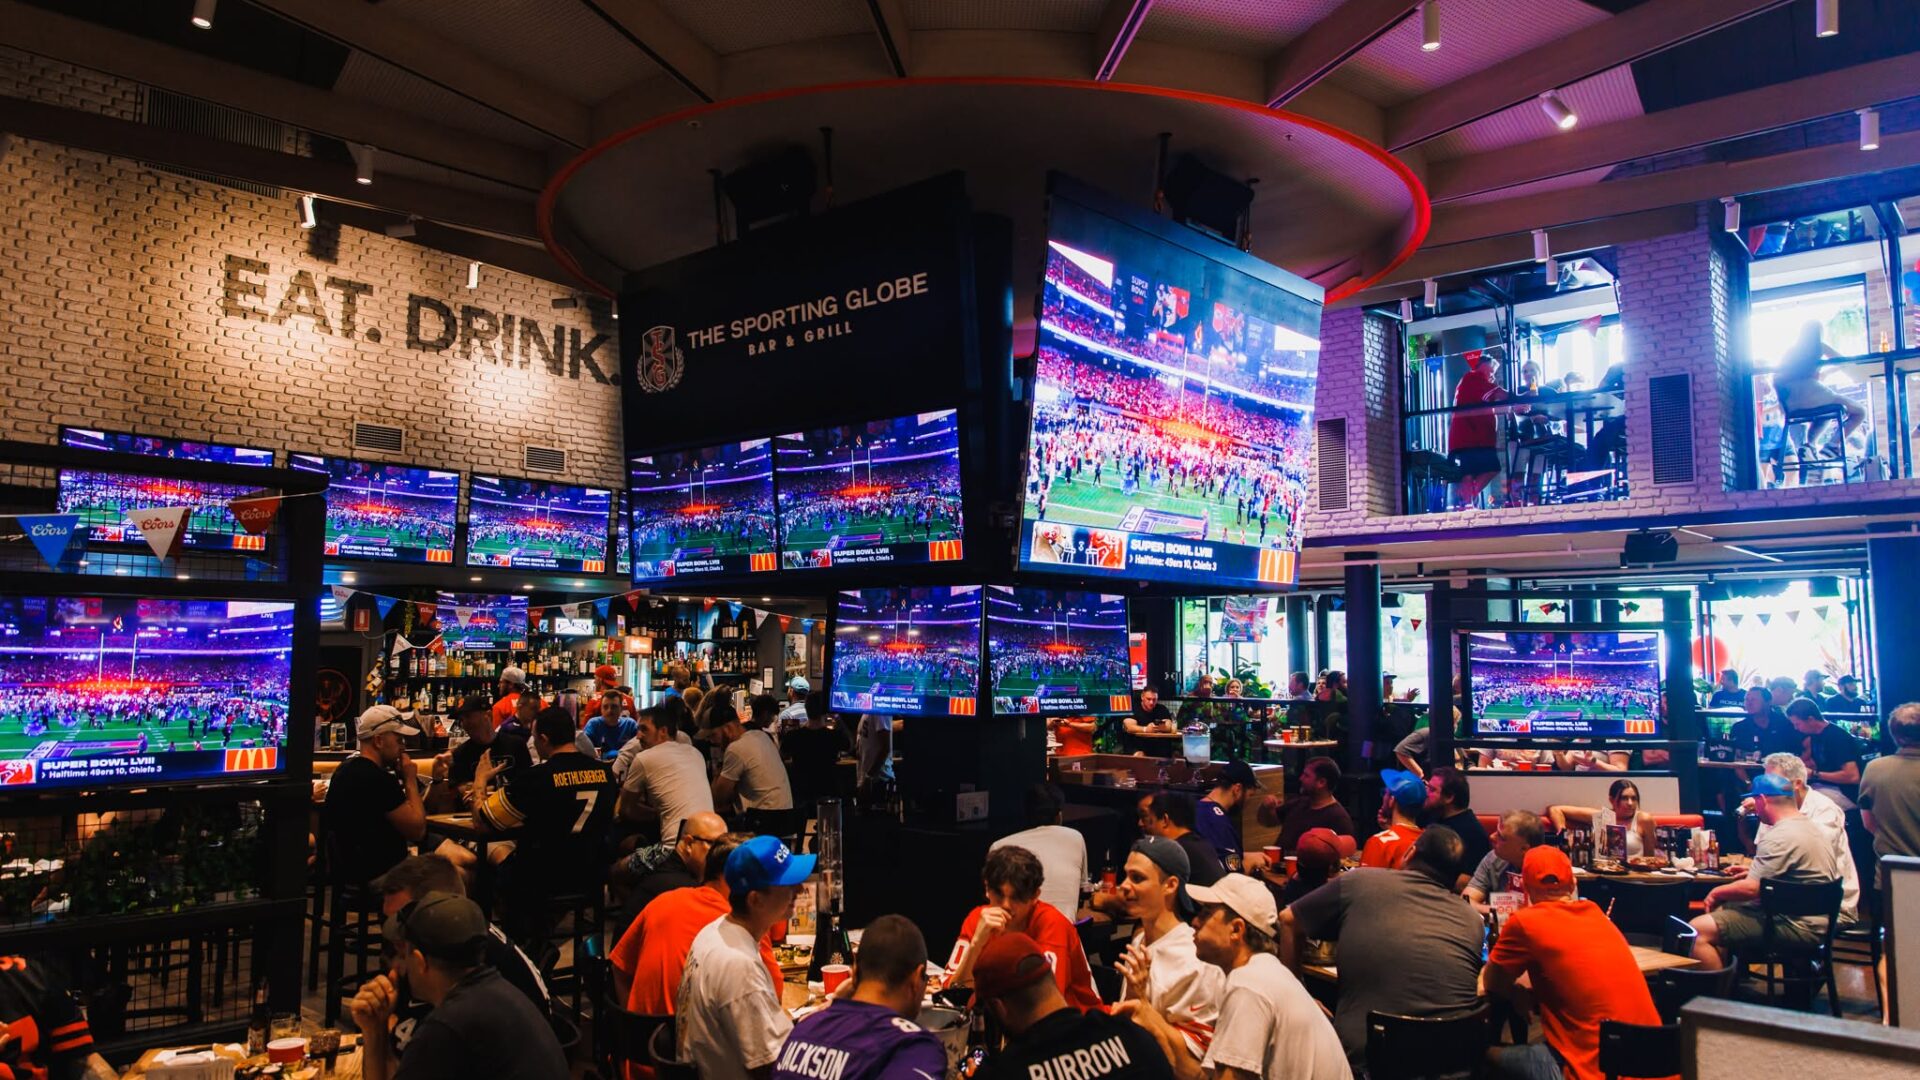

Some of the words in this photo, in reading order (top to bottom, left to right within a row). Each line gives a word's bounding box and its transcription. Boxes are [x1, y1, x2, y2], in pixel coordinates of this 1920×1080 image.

[687, 324, 725, 349] THE
[730, 296, 838, 338] SPORTING
[846, 272, 928, 310] GLOBE
[222, 254, 382, 344] EAT.
[406, 293, 620, 386] DRINK.
[748, 338, 776, 356] BAR
[786, 335, 794, 348] &
[804, 321, 852, 342] GRILL
[241, 508, 272, 520] Coors
[32, 524, 68, 536] Coors
[141, 518, 174, 530] Coors
[1130, 539, 1164, 553] SUPER
[1166, 543, 1193, 556] BOWL
[1135, 554, 1164, 566] Halftime:
[1165, 557, 1183, 568] 49ers
[1193, 560, 1212, 570] Chiefs
[1212, 562, 1217, 571] 3
[42, 760, 88, 770] SUPER
[90, 758, 128, 768] BOWL
[49, 770, 88, 778] Halftime:
[553, 770, 608, 787] ROETHLISBERGER
[572, 790, 599, 832] 7
[777, 1041, 850, 1080] JACKSON
[1028, 1035, 1131, 1080] BURROW
